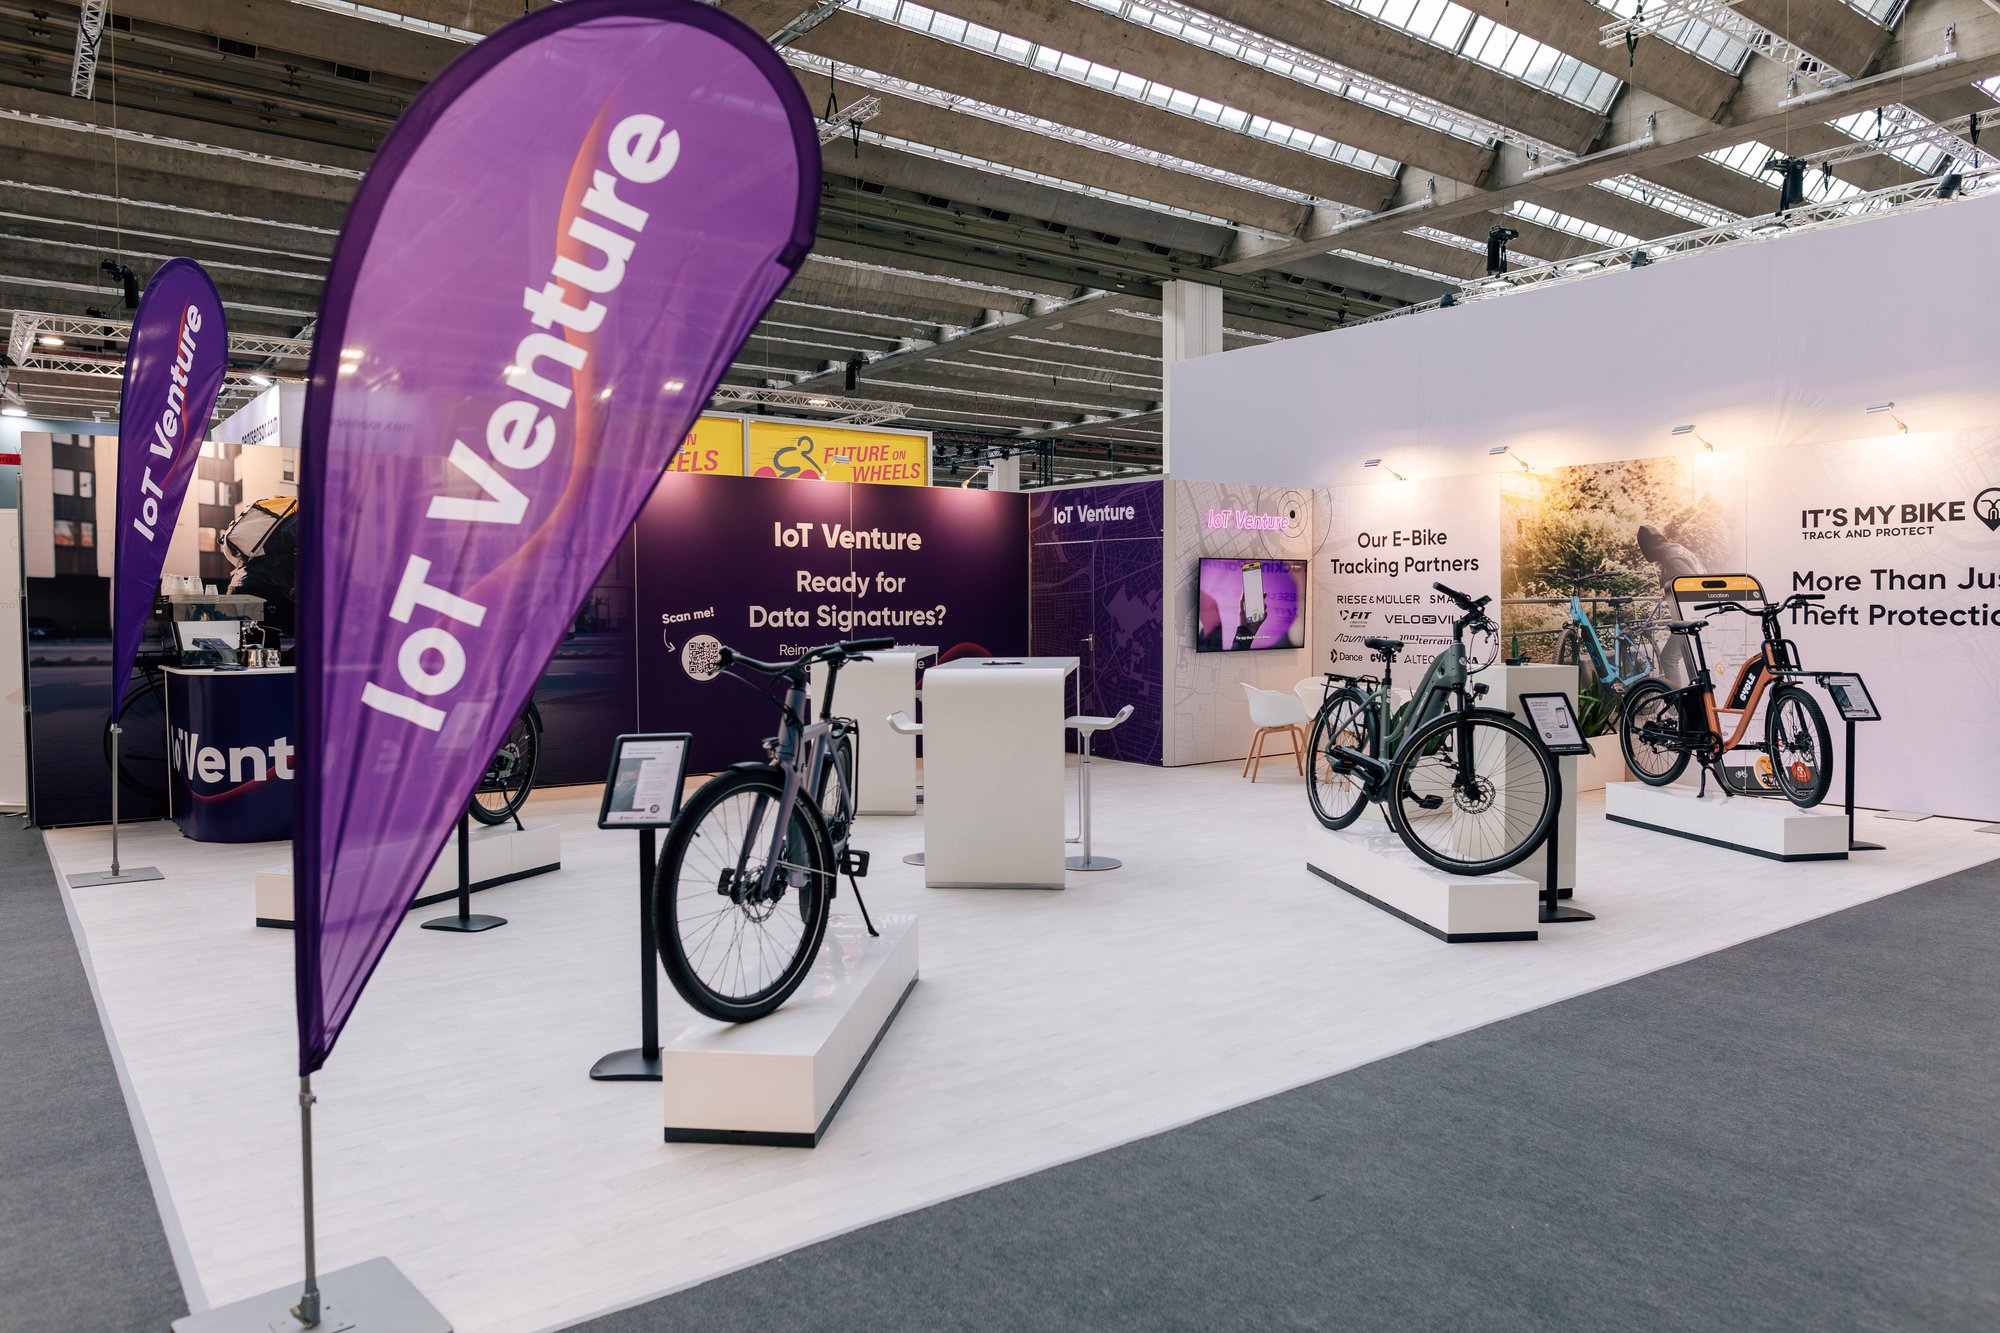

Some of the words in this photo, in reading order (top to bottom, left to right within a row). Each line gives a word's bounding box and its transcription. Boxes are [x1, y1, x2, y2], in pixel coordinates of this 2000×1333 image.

[133, 466, 164, 542] IoT
[149, 303, 202, 460] Venture
[360, 553, 488, 732] IoT
[425, 114, 681, 525] Venture
[892, 450, 906, 461] ON
[849, 462, 921, 482] WHEELS
[1053, 506, 1074, 524] IoT
[1077, 504, 1135, 522] Venture
[1207, 509, 1232, 529] IoT
[1235, 510, 1290, 530] Venture
[1801, 507, 1848, 529] IT'S
[1854, 504, 1896, 526] MY
[1901, 500, 1966, 524] BIKE
[774, 521, 814, 548] IoT
[821, 523, 922, 550] Venture
[1357, 532, 1388, 548] Our
[1393, 529, 1448, 547] E-Bike
[1802, 530, 1841, 540] TRACK
[1845, 529, 1872, 539] AND
[1876, 526, 1935, 537] PROTECT
[1330, 557, 1399, 578] Tracking
[1404, 556, 1480, 573] Partners
[796, 570, 870, 598] Ready
[875, 571, 906, 593] for
[1792, 570, 1862, 591] More
[1870, 568, 1946, 591] Than
[1957, 566, 2000, 590] Ju
[1336, 595, 1368, 604] RIESE
[661, 613, 692, 624] Scan
[693, 606, 715, 620] me!
[749, 605, 810, 628] Data
[816, 604, 947, 632] Signatures?
[1350, 611, 1373, 620] FIT
[1787, 603, 1859, 625] Theft
[1418, 637, 1453, 645] terrain
[1339, 652, 1363, 661] Dance
[1739, 672, 1756, 702] CYCLE
[184, 731, 296, 783] Vent
